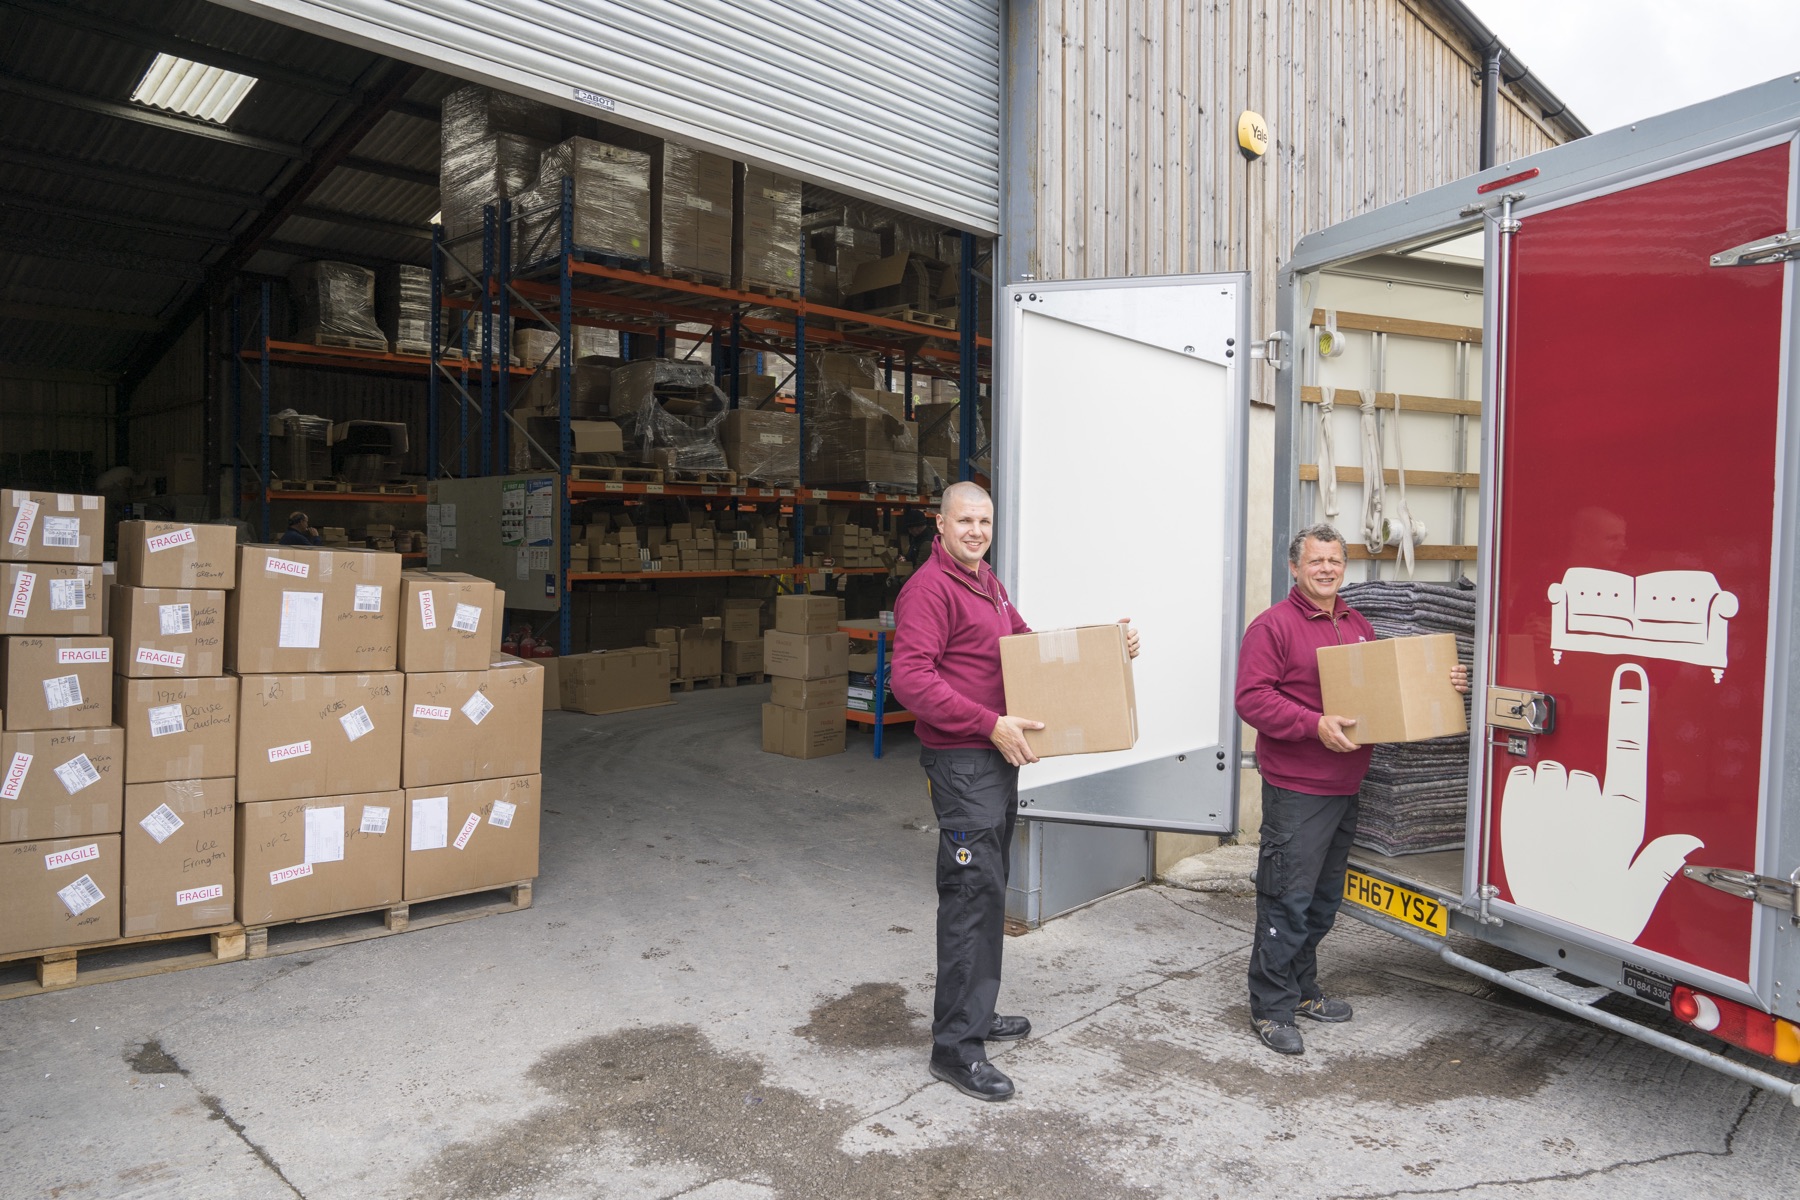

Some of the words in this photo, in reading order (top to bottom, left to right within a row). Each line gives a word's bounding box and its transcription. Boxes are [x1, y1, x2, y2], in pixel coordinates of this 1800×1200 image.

[1251, 123, 1268, 144] Yale
[13, 502, 35, 544] FRAGILE
[150, 531, 192, 549] FRAGILE
[268, 559, 307, 575] FRAGILE
[13, 573, 32, 615] FRAGILE
[422, 592, 434, 628] FRAGILE
[61, 650, 107, 660] FRAGILE
[139, 651, 182, 665] FRAGILE
[185, 703, 223, 718] Denise
[415, 707, 449, 718] FRAGILE
[271, 743, 310, 759] FRAGILE
[4, 755, 29, 797] FRAGILE
[280, 832, 290, 842] 2
[456, 815, 478, 847] FRAGILE
[195, 839, 218, 853] Lee
[48, 846, 97, 867] FRAGILE
[183, 851, 227, 873] Errington
[273, 864, 311, 882] FRAGILE
[179, 887, 221, 903] FRAGILE
[1347, 873, 1395, 910] FH67
[1400, 891, 1439, 929] YSZ
[1627, 977, 1651, 993] 01884
